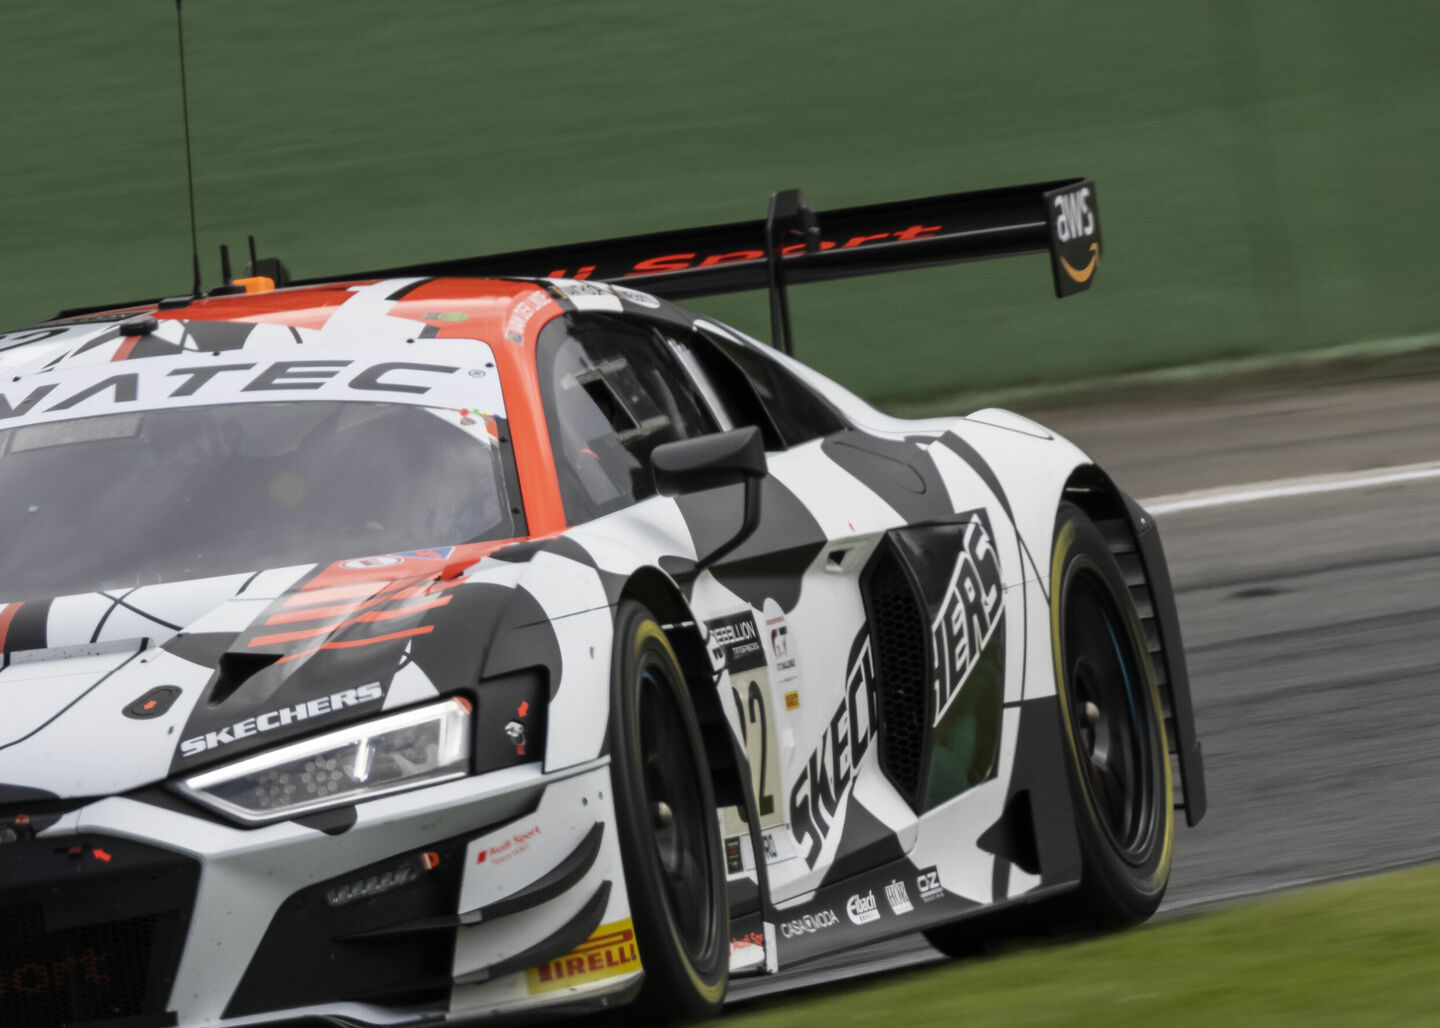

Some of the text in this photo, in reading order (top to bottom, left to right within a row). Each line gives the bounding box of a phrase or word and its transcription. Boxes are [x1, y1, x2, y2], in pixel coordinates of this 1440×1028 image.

[1054, 187, 1094, 243] aws
[180, 682, 383, 758] SKECHERS
[536, 929, 636, 983] PIRELLI
